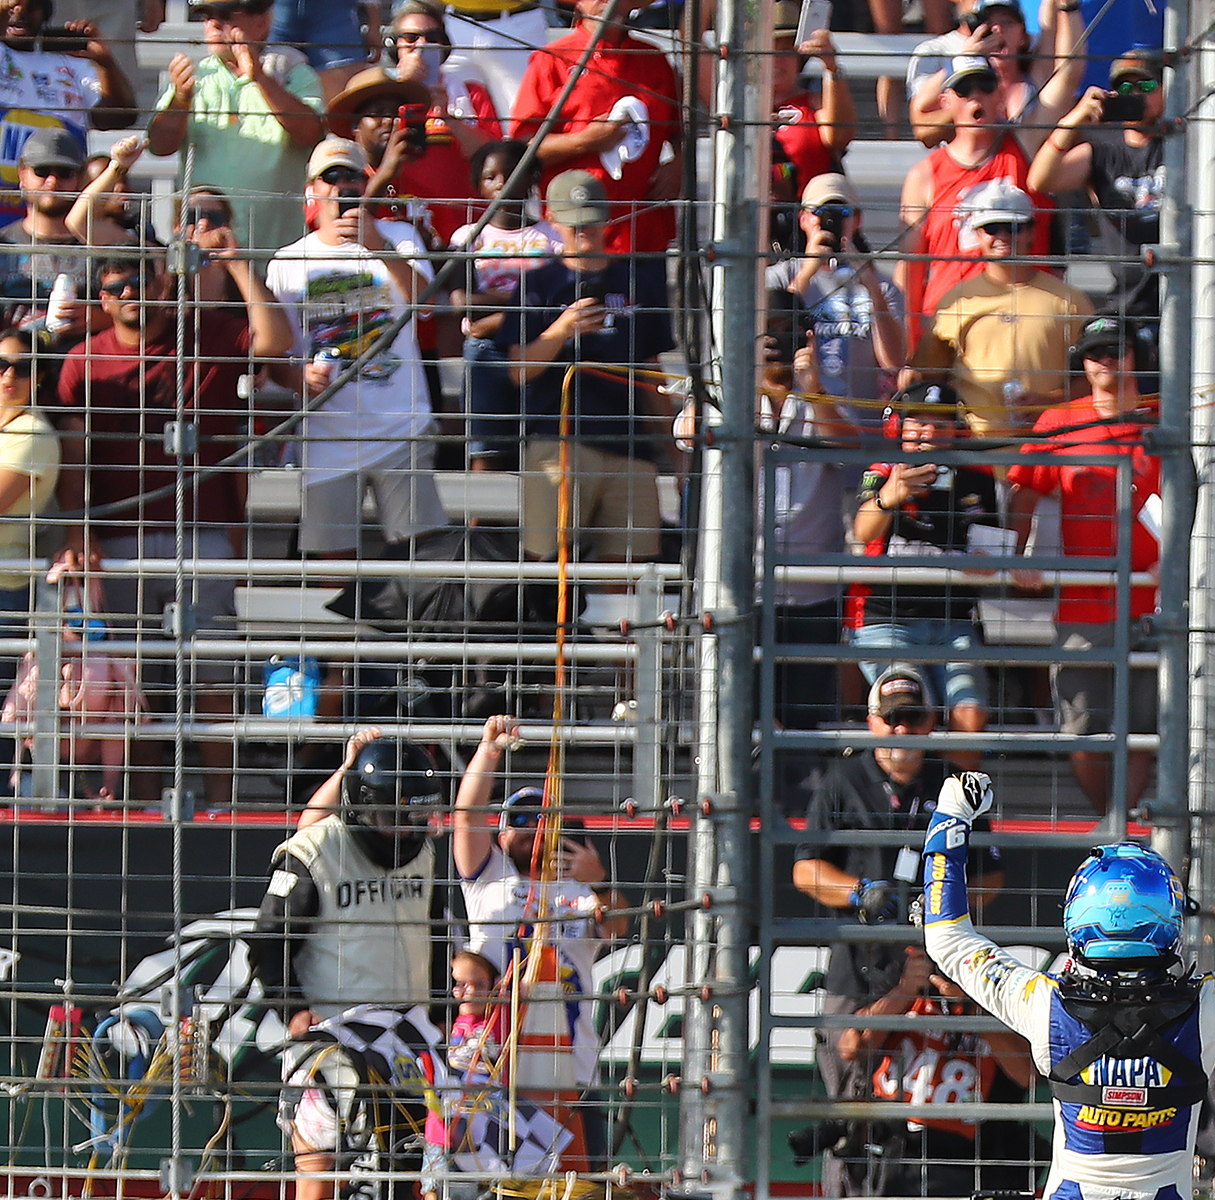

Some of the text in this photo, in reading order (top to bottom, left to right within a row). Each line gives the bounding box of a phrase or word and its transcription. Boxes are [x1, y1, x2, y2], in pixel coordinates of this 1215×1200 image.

[1107, 1090, 1143, 1101] SIMPSON
[1077, 1106, 1177, 1128] AUTO PARTS
